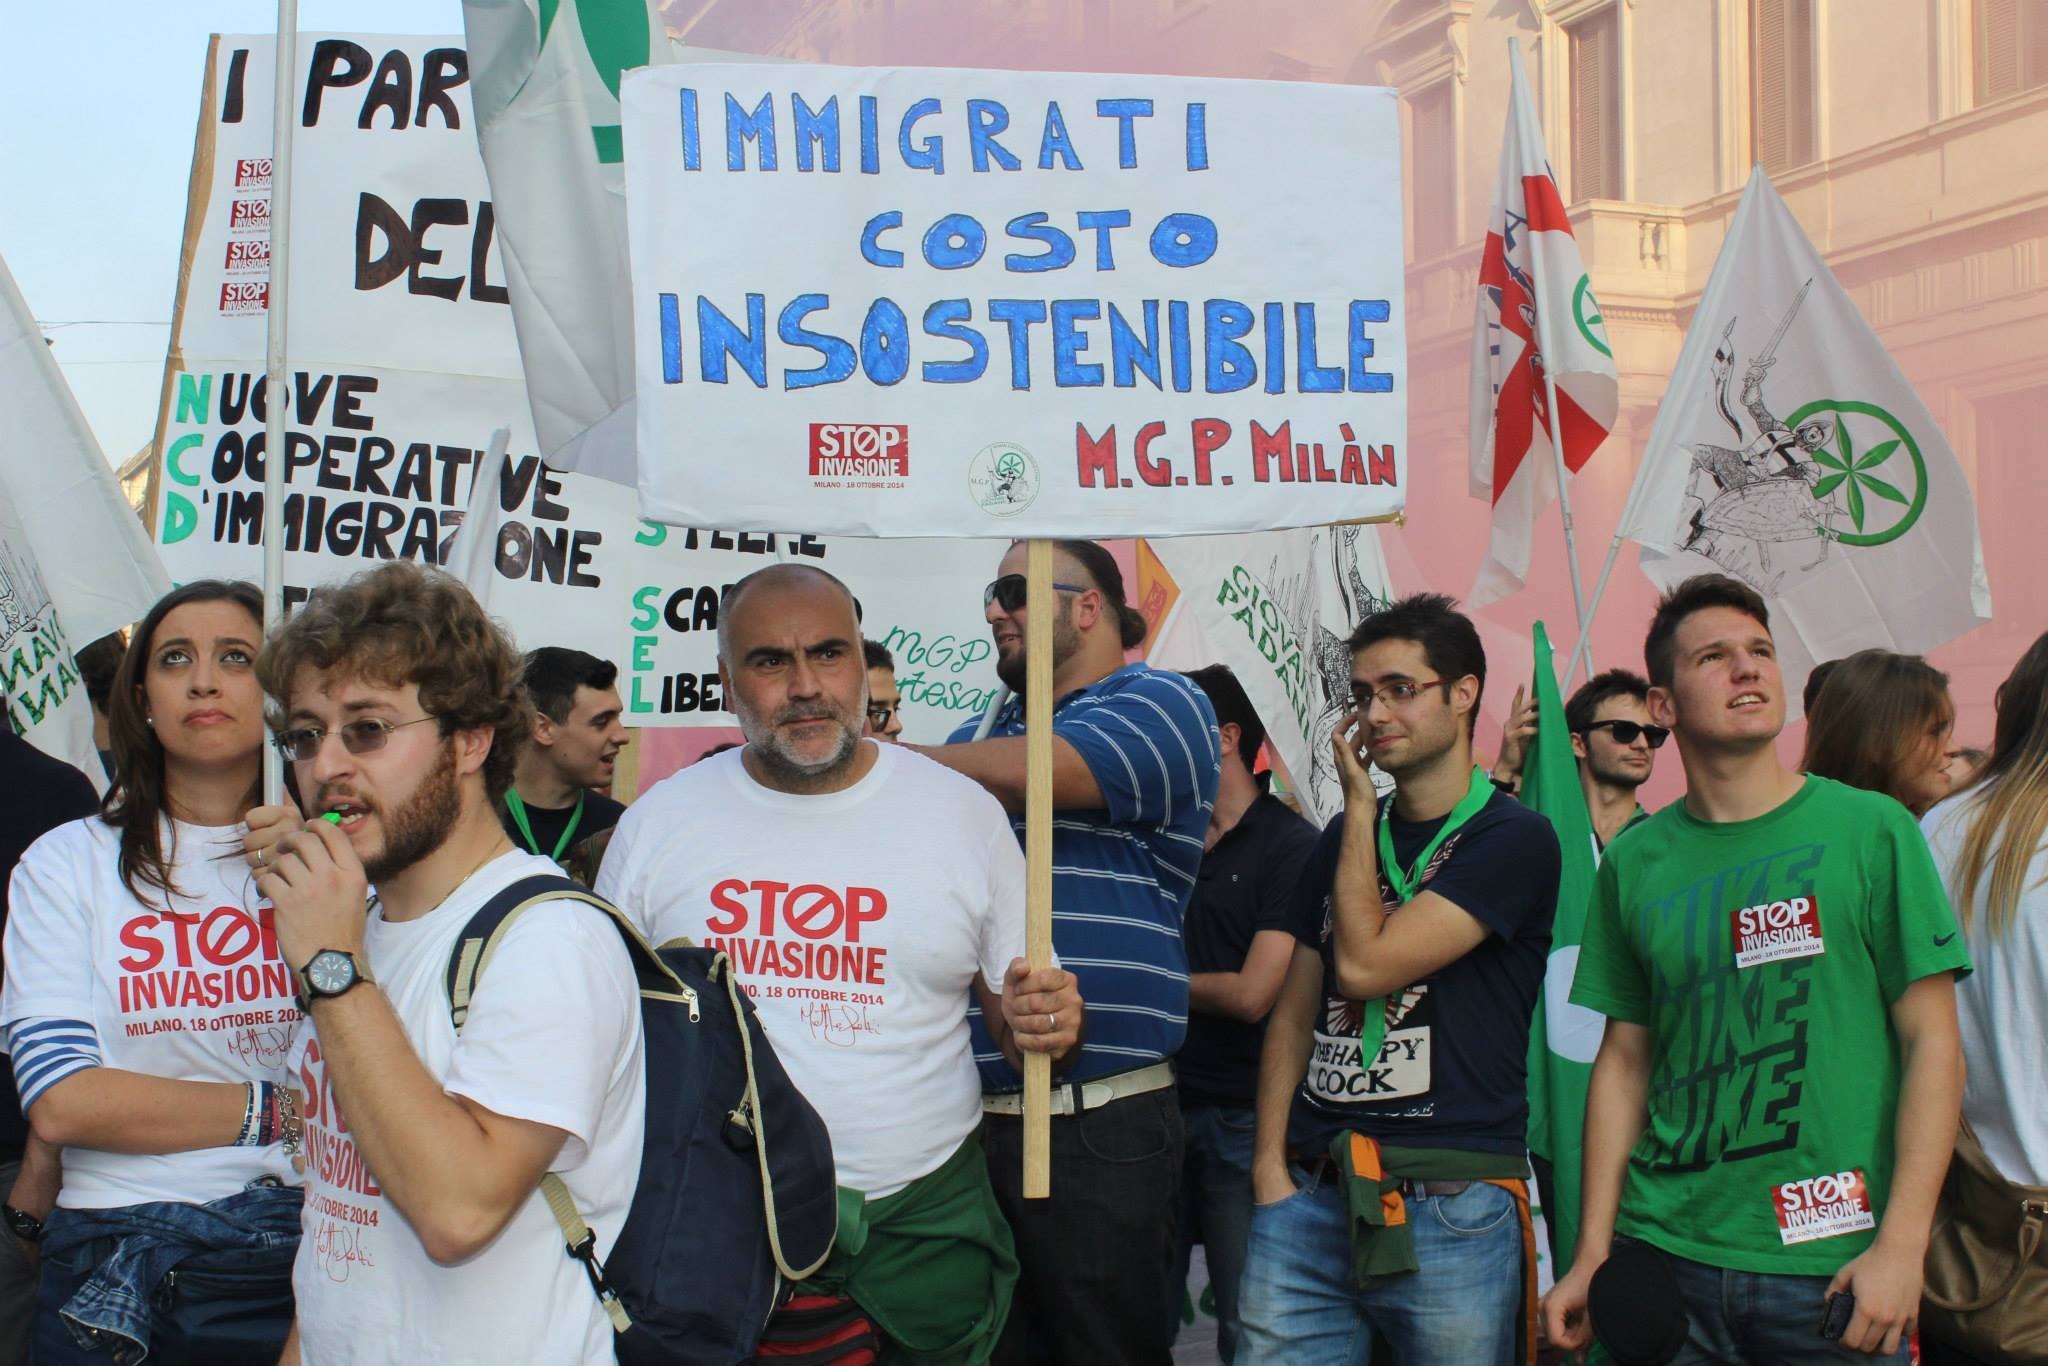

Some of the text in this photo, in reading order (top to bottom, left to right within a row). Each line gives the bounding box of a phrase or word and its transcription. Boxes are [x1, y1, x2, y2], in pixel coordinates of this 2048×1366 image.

[222, 49, 249, 123] I
[680, 88, 1209, 174] IMMIGRATI
[240, 160, 272, 177] STO
[230, 241, 270, 259] STOP
[860, 209, 1218, 272] COSTO
[223, 299, 265, 312] INVASIONE
[225, 283, 267, 301] STOP
[659, 293, 1394, 395] INSOSTENIBILE
[818, 424, 900, 458] STOP
[1076, 418, 1233, 489] M.G.P.
[818, 457, 900, 477] INVASIONE
[814, 481, 841, 489] MILANO
[856, 481, 885, 489] OTTOBRE
[887, 481, 905, 489] 2014
[706, 878, 888, 943] STOP
[1739, 897, 1810, 935] STOP
[1741, 923, 1815, 953] INVASIONE
[1741, 954, 1761, 963] MILANO
[1774, 946, 1802, 956] OTTOBRE
[1804, 943, 1820, 951] 2014
[766, 986, 783, 998] 18
[787, 987, 848, 1002] OTTOBRE
[851, 993, 885, 1006] 2014
[190, 1018, 207, 1031] 18
[210, 1010, 273, 1031] OTTOBRE
[278, 1008, 304, 1023] 201
[1317, 1068, 1398, 1096] COCK
[1780, 1171, 1857, 1211] STOP
[350, 1206, 379, 1227] 2014
[1785, 1198, 1864, 1229] INVASIONE
